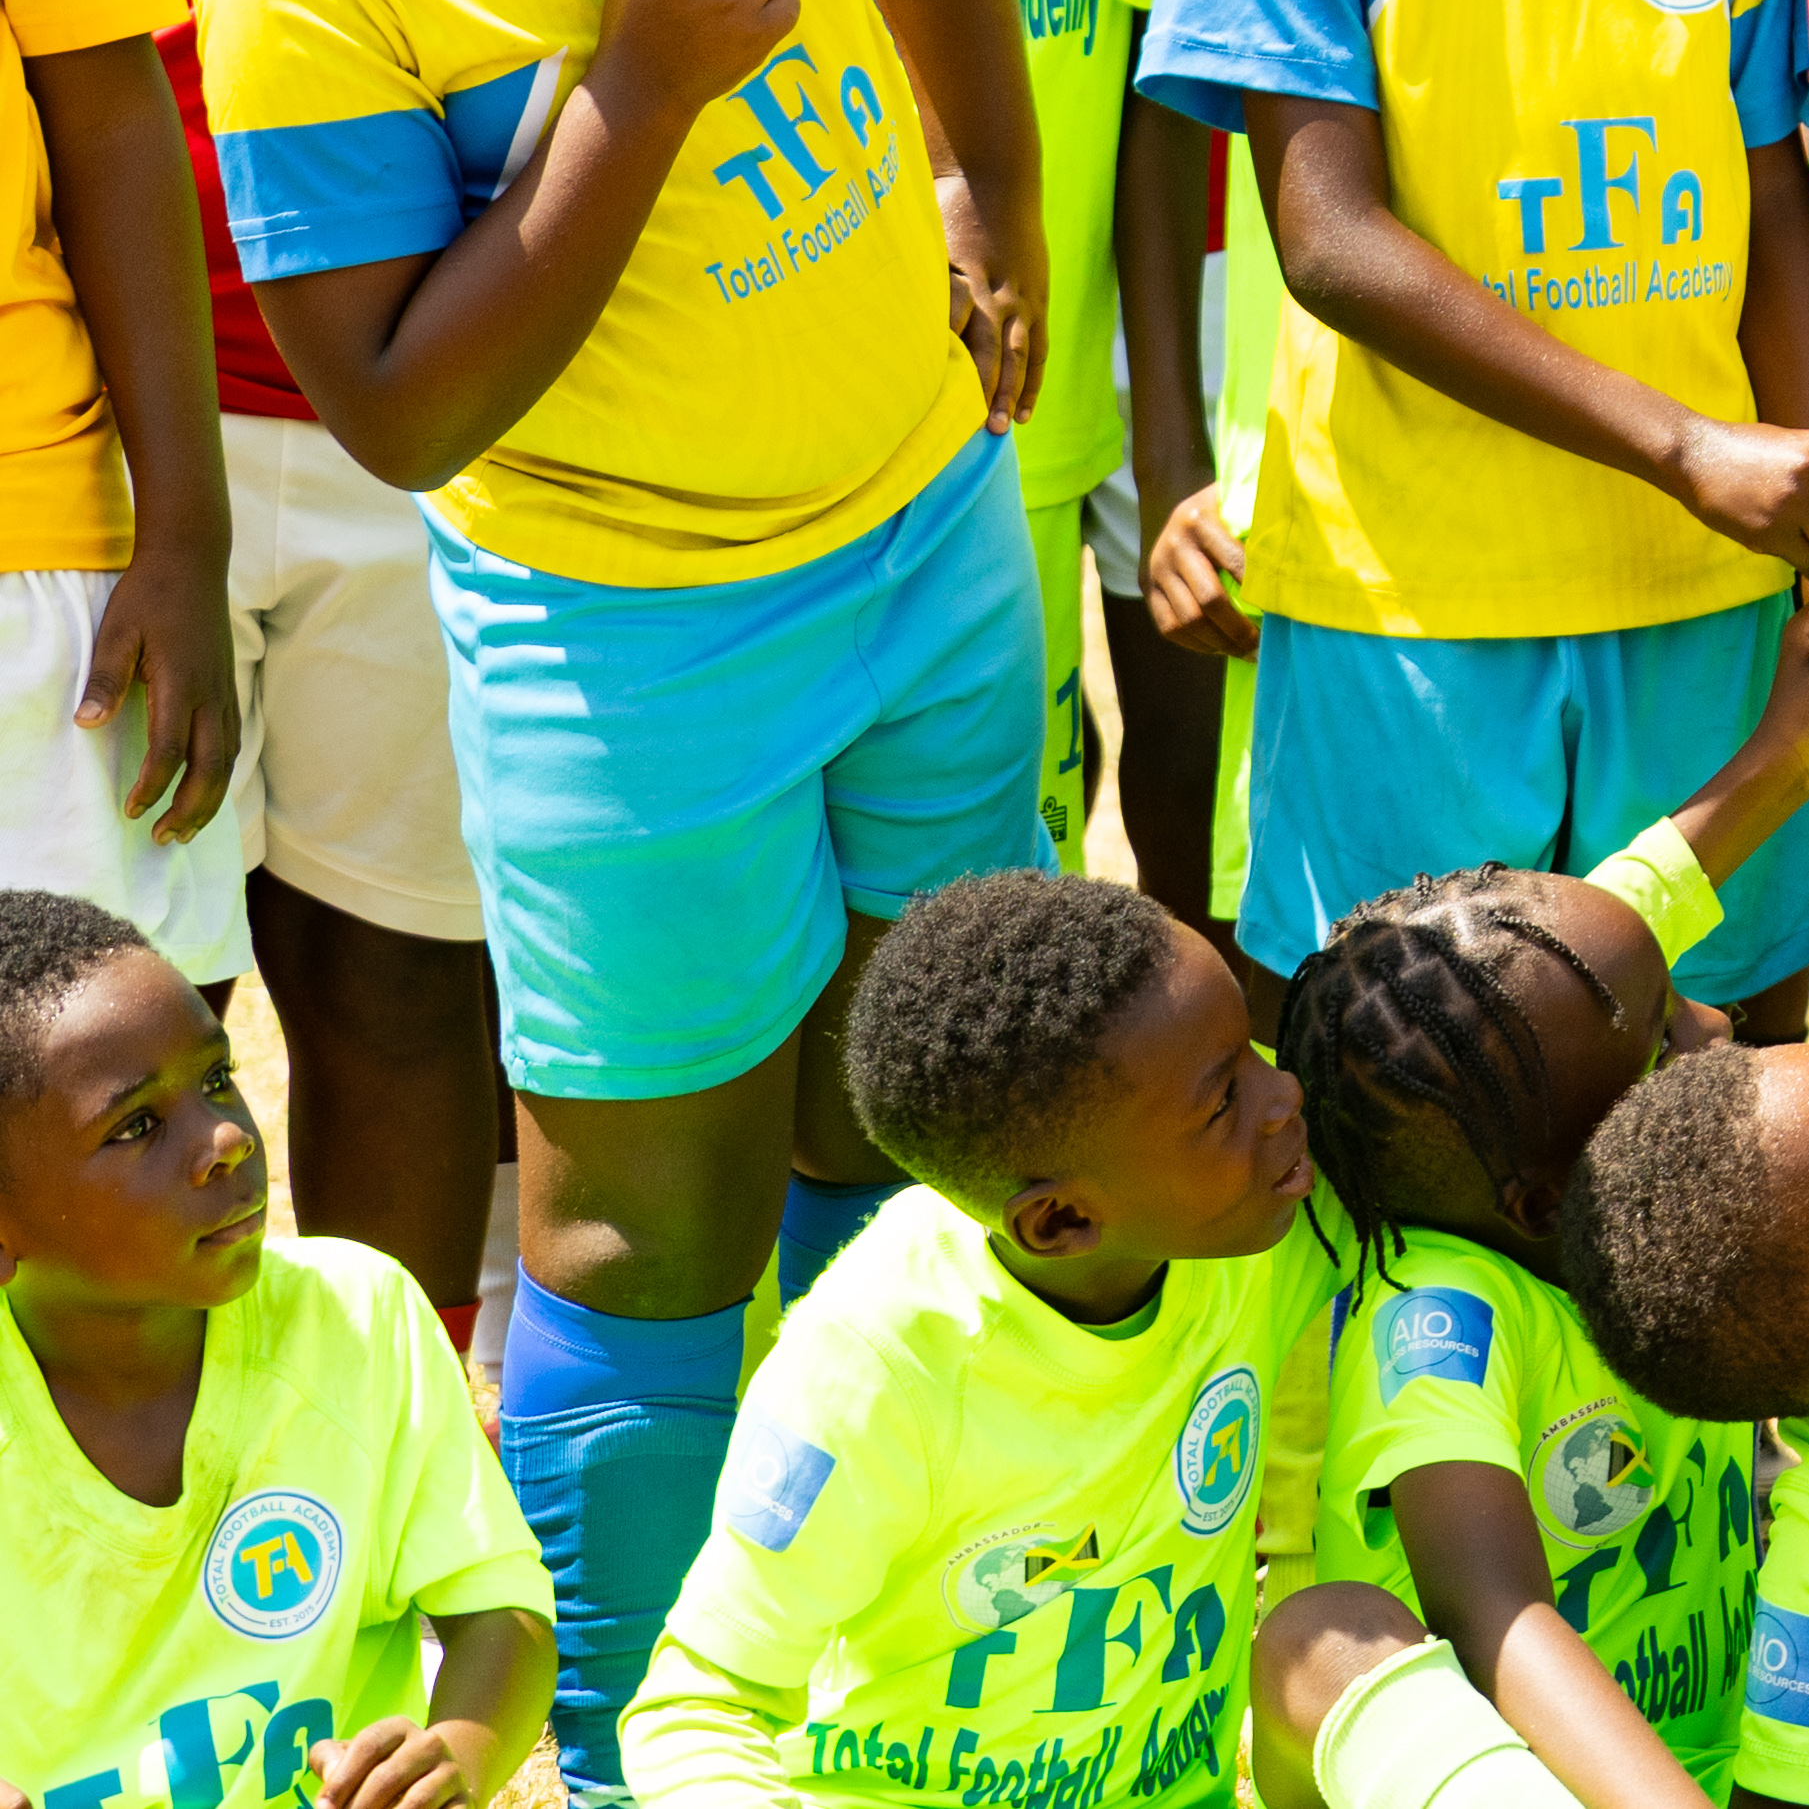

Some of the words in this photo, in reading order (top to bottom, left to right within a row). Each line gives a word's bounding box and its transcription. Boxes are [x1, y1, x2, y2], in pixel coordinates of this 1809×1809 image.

[713, 43, 884, 222] TFA
[1496, 116, 1703, 255] TFA
[704, 240, 785, 305] Total
[780, 179, 870, 272] Football
[1526, 261, 1638, 311] Football
[1644, 255, 1735, 303] Academy
[1392, 1310, 1453, 1351] AIO
[1407, 1338, 1480, 1359] RESOURCES
[218, 1501, 286, 1551] FOOTBALL
[292, 1503, 337, 1562] ACADEMY
[947, 1521, 1042, 1567] AMBASSADOR
[212, 1556, 229, 1604] TOTAL
[1614, 1609, 1709, 1725] otball
[806, 1720, 935, 1790] Total
